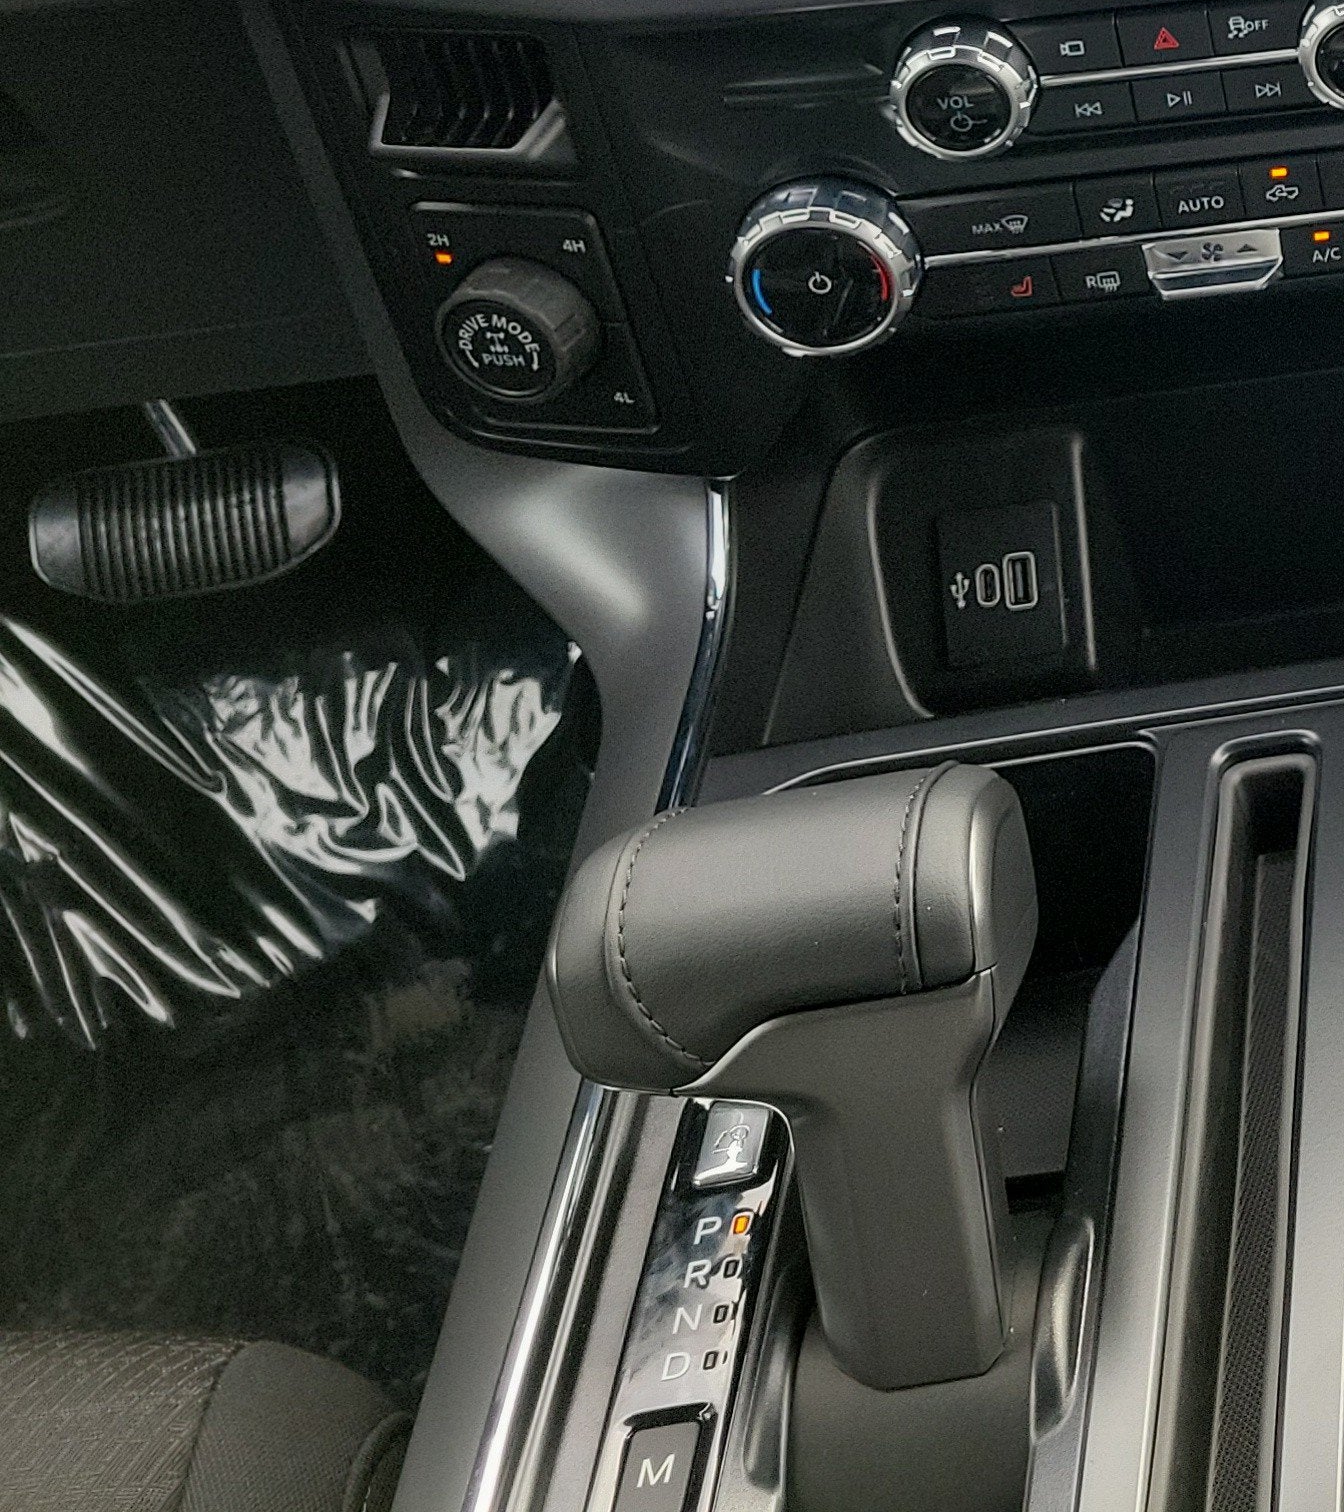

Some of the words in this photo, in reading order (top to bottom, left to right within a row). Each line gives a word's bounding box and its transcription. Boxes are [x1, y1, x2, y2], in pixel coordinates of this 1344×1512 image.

[1247, 19, 1269, 33] OFF
[937, 95, 974, 111] VOL
[1178, 196, 1225, 213] AUTO
[971, 221, 1002, 236] MAX
[427, 233, 450, 247] 2H
[562, 239, 586, 253] 4H
[1312, 247, 1342, 263] A/C
[458, 313, 490, 351] DRIVE
[491, 314, 540, 352] MODE
[482, 352, 526, 367] PUSH
[613, 391, 635, 404] 4L
[694, 1216, 722, 1245] P
[684, 1260, 712, 1289] R
[673, 1307, 703, 1336] N
[661, 1354, 691, 1382] D
[636, 1453, 675, 1488] M
